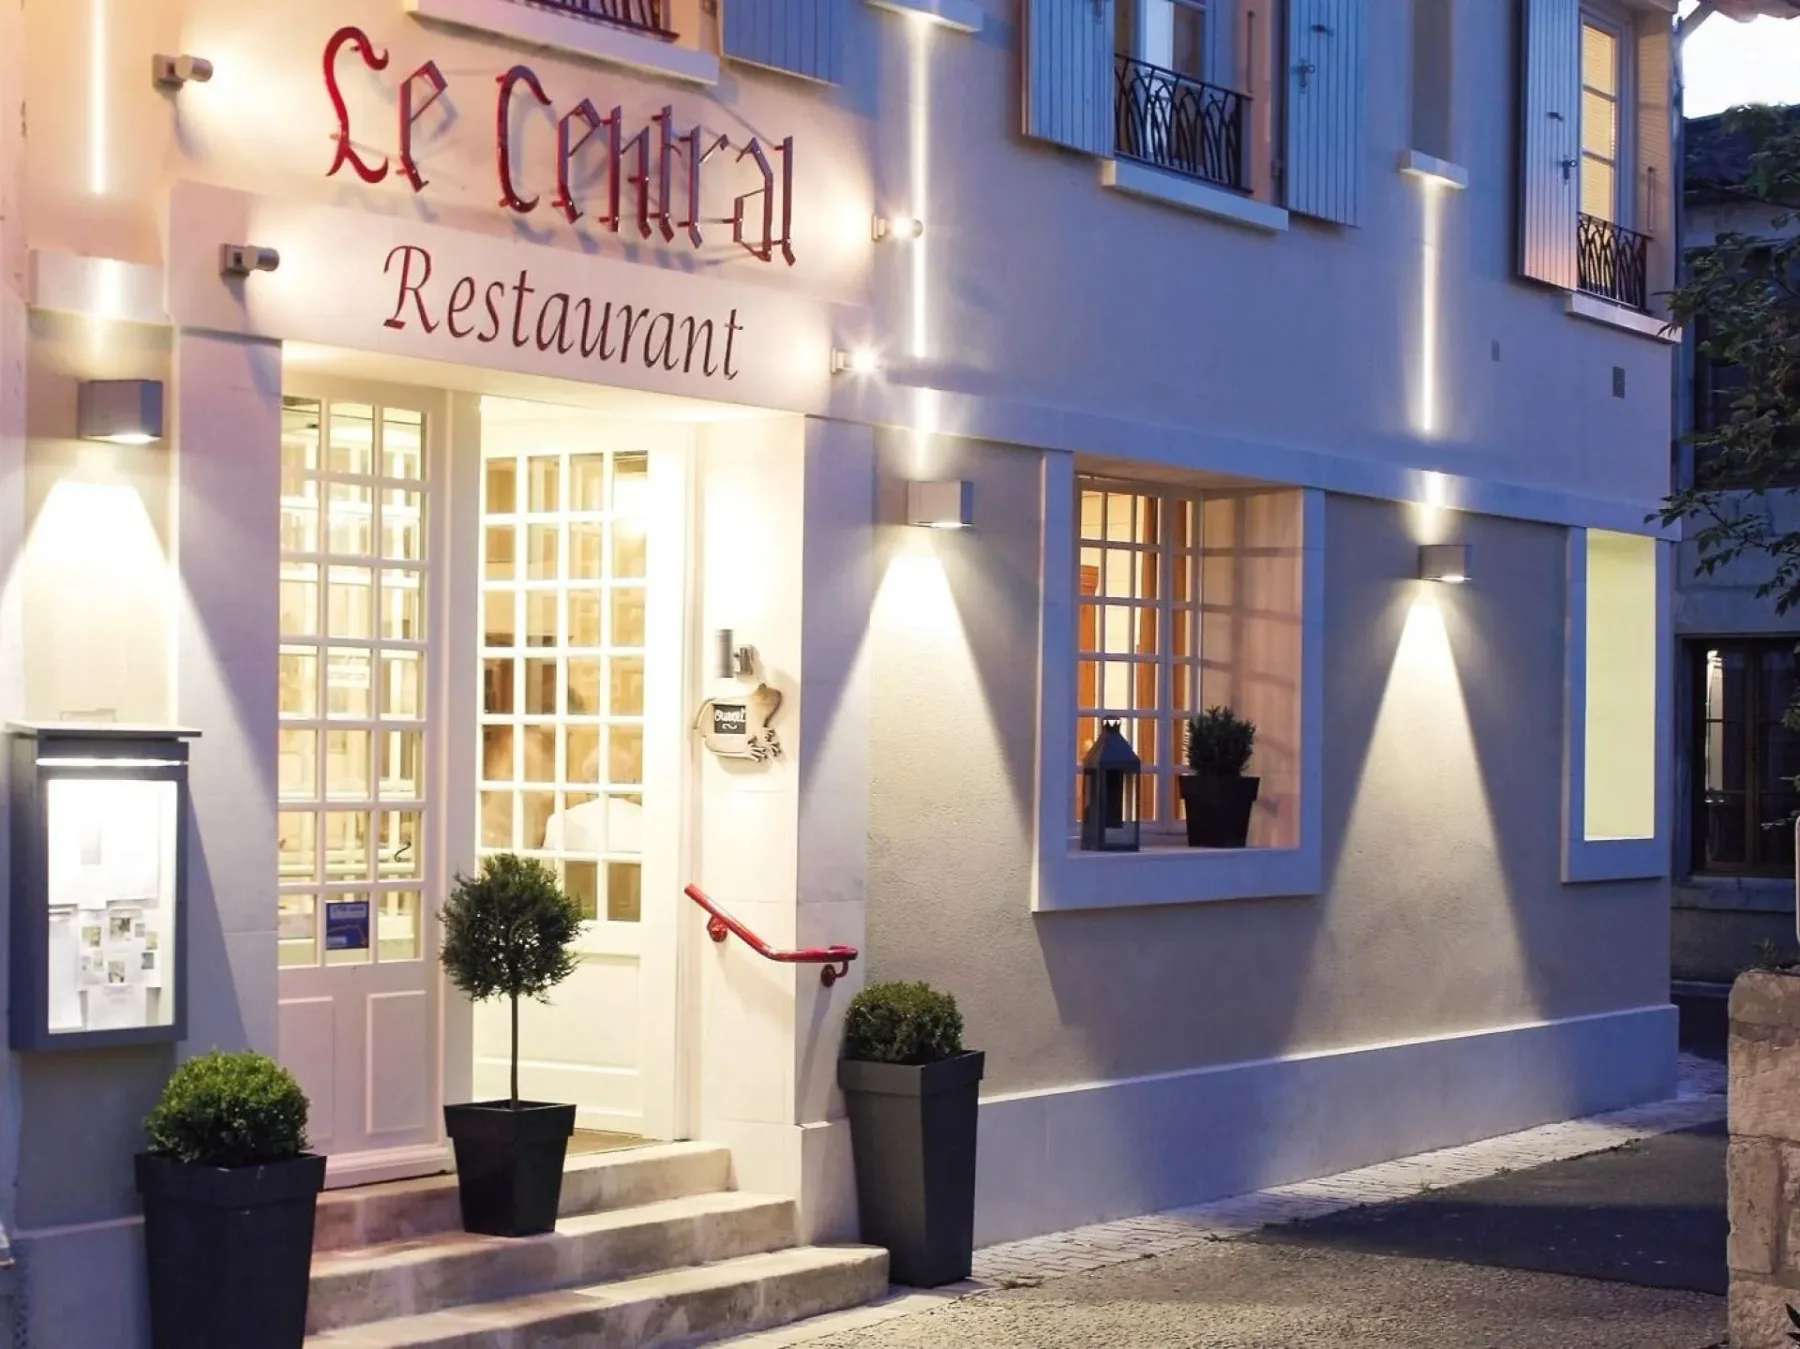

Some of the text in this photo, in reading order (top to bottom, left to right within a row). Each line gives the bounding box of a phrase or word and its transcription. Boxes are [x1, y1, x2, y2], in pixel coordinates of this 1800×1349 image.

[323, 26, 796, 267] Le Central
[383, 245, 744, 380] Restaurant
